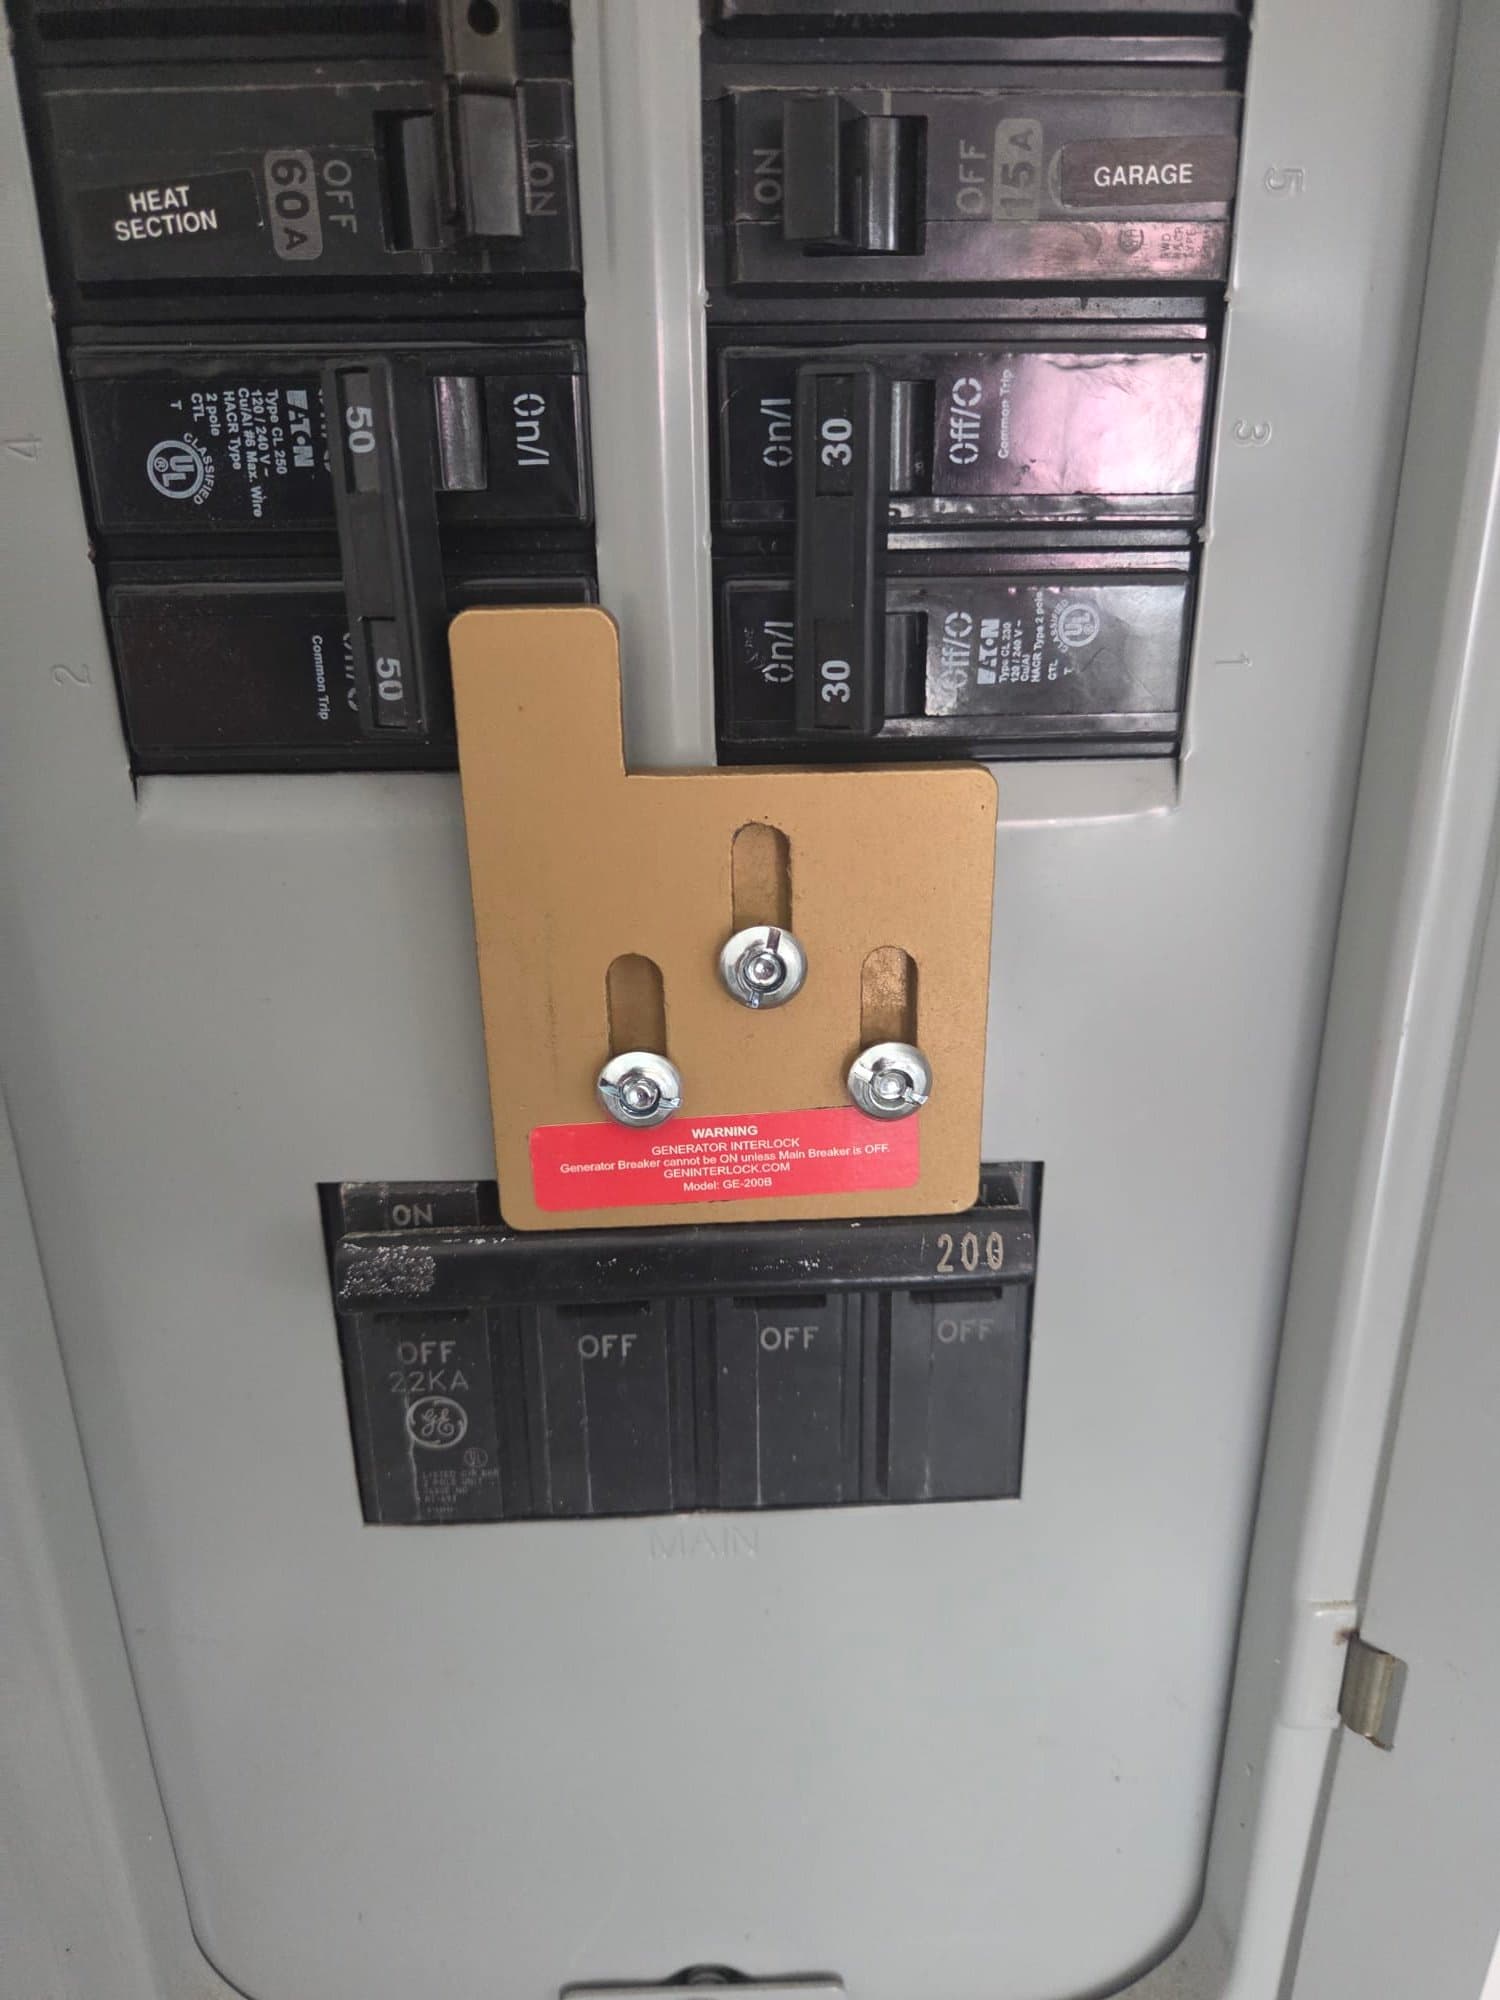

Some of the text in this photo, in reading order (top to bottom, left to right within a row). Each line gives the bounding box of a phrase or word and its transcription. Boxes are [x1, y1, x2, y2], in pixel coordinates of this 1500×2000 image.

[753, 148, 781, 204] ON
[956, 139, 986, 214] OFF
[999, 128, 1034, 216] 15A
[1094, 163, 1193, 187] GARAGE
[1264, 166, 1307, 194] 5
[128, 184, 191, 213] HEAT
[271, 158, 309, 251] 60A
[323, 160, 357, 233] OFF
[527, 161, 558, 217] ON
[114, 207, 218, 242] SECTION
[170, 400, 182, 411] T
[191, 392, 205, 422] CTL
[205, 392, 221, 437] 2 pole
[238, 387, 254, 427] Cu/Al
[251, 389, 264, 415] 120
[997, 368, 1013, 459] Common Trip
[223, 389, 242, 470] HACR Type
[255, 425, 270, 451] 240
[265, 388, 288, 475] Type CL 250
[345, 405, 376, 454] 50
[821, 417, 853, 467] 30
[1232, 417, 1272, 447] 3
[182, 432, 215, 505] CLASSIFIED
[246, 450, 258, 483] Max.
[258, 452, 271, 465] V
[250, 485, 265, 518] Wire
[1031, 591, 1045, 683] HACR Type 2 pole
[1050, 599, 1070, 653] CLASSIFIED
[1000, 641, 1010, 657] CL
[1012, 640, 1022, 658] 240
[50, 663, 95, 688] 2
[312, 634, 331, 720] Common Trip
[376, 657, 404, 701] 50
[821, 659, 851, 704] 30
[999, 658, 1011, 684] Type
[1010, 665, 1021, 683] 120
[651, 1137, 800, 1156] GENERATOR INTERLOCK
[691, 1124, 758, 1140] WARNING
[560, 1143, 890, 1175] Generator Breaker cannot be ON unless Main Breaker is OFF.
[663, 1161, 791, 1179] GENINTERLOCK.COM
[682, 1177, 773, 1193] Model: GE-200B
[392, 1203, 434, 1227] ON
[935, 1231, 1005, 1273] 200
[577, 1333, 638, 1360] OFF
[759, 1325, 820, 1352] OFF
[937, 1319, 996, 1345] OFF
[397, 1340, 456, 1365] OFF
[388, 1368, 470, 1393] 22KA
[648, 1526, 760, 1561] MAIN
